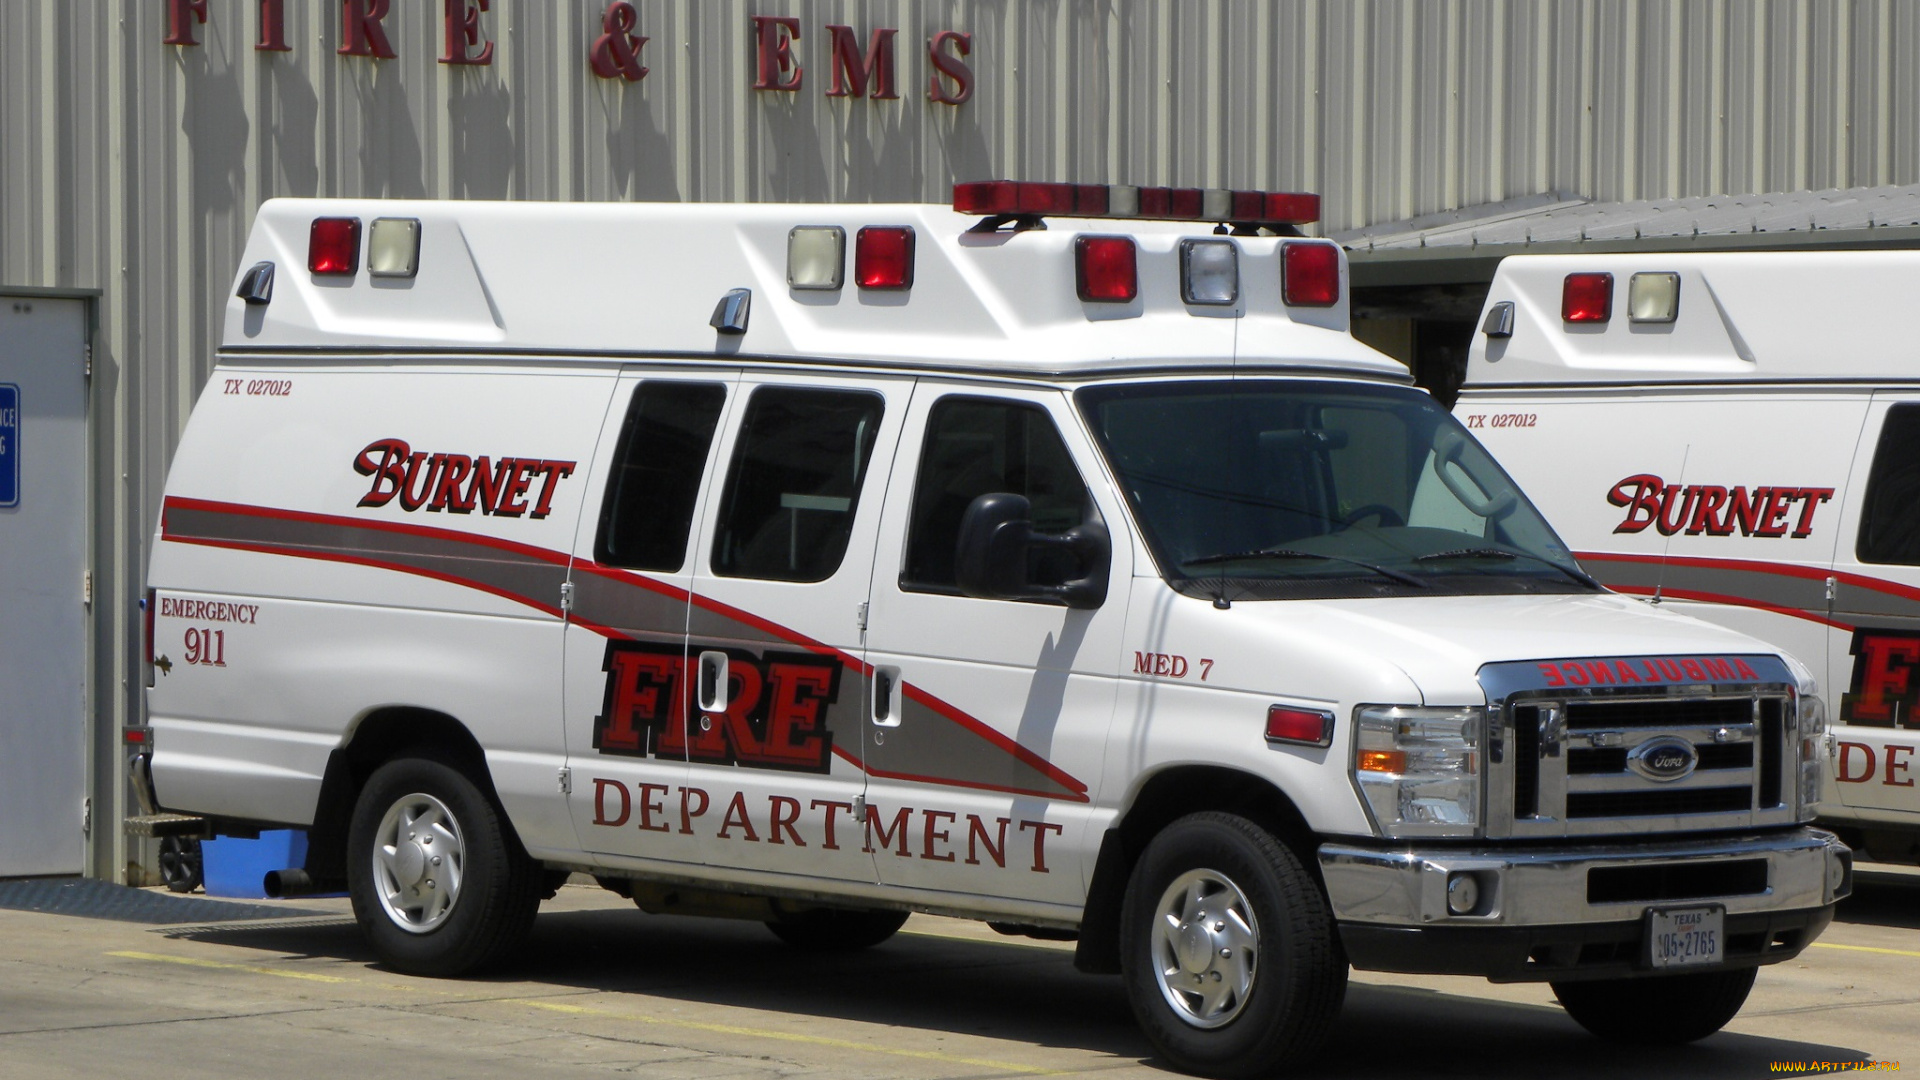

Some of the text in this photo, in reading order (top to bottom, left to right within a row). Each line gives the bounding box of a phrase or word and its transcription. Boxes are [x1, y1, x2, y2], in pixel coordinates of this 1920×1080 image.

[163, 0, 972, 105] FIRE & EMS
[224, 379, 292, 396] TX 027012
[1468, 413, 1537, 428] TX 027012
[353, 438, 577, 519] BURNET
[1607, 473, 1835, 538] BURNET
[161, 597, 259, 624] EMERGENCY
[184, 627, 227, 667] 911
[1133, 650, 1214, 681] MED 7
[1841, 629, 1920, 727] F
[595, 640, 841, 772] FIRE
[1655, 754, 1684, 768] Ford
[592, 778, 1063, 874] DEPARTMENT
[1674, 913, 1702, 925] TEXAS
